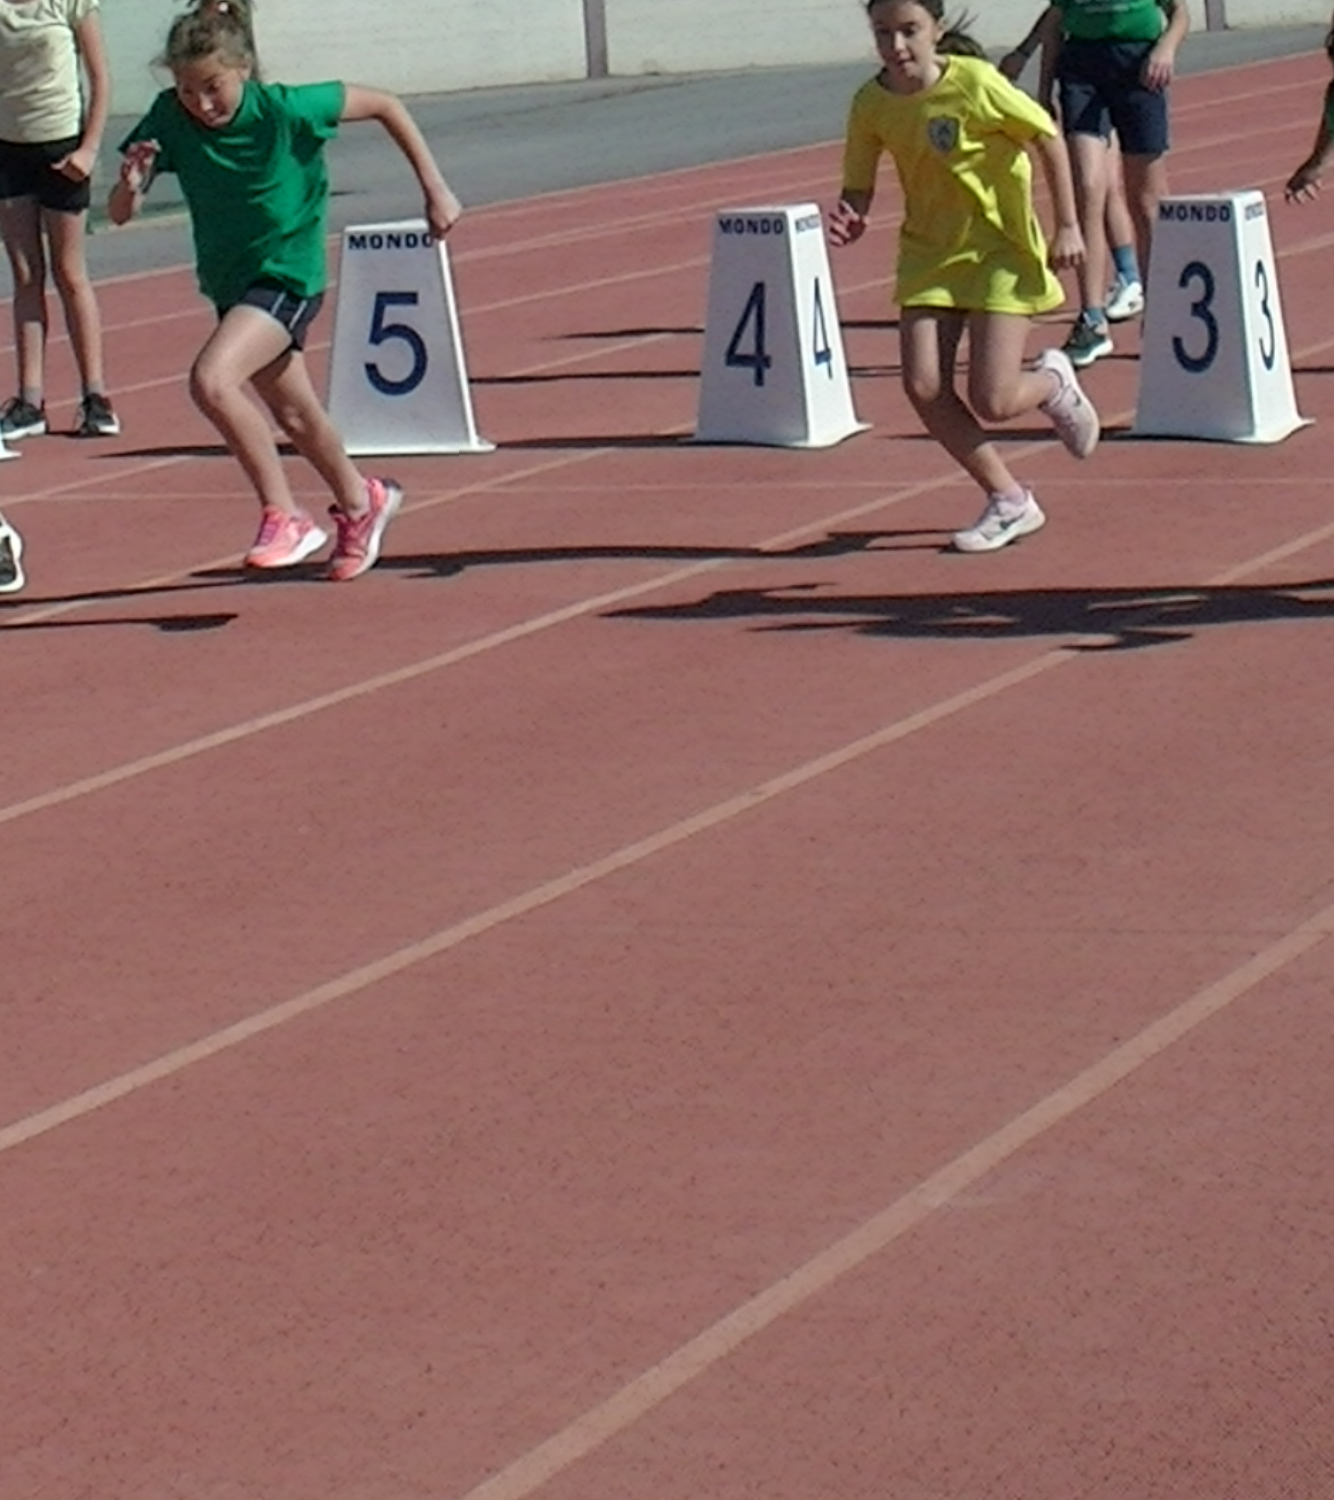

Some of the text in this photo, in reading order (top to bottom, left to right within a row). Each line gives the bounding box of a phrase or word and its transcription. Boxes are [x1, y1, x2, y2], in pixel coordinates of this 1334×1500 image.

[348, 232, 434, 250] MONDO
[719, 218, 784, 235] MONDO
[1159, 204, 1231, 222] MONDO
[364, 291, 428, 396] 5
[725, 281, 772, 387] 4
[813, 275, 832, 380] 4
[1172, 261, 1219, 373] 3
[1255, 258, 1275, 371] 3
